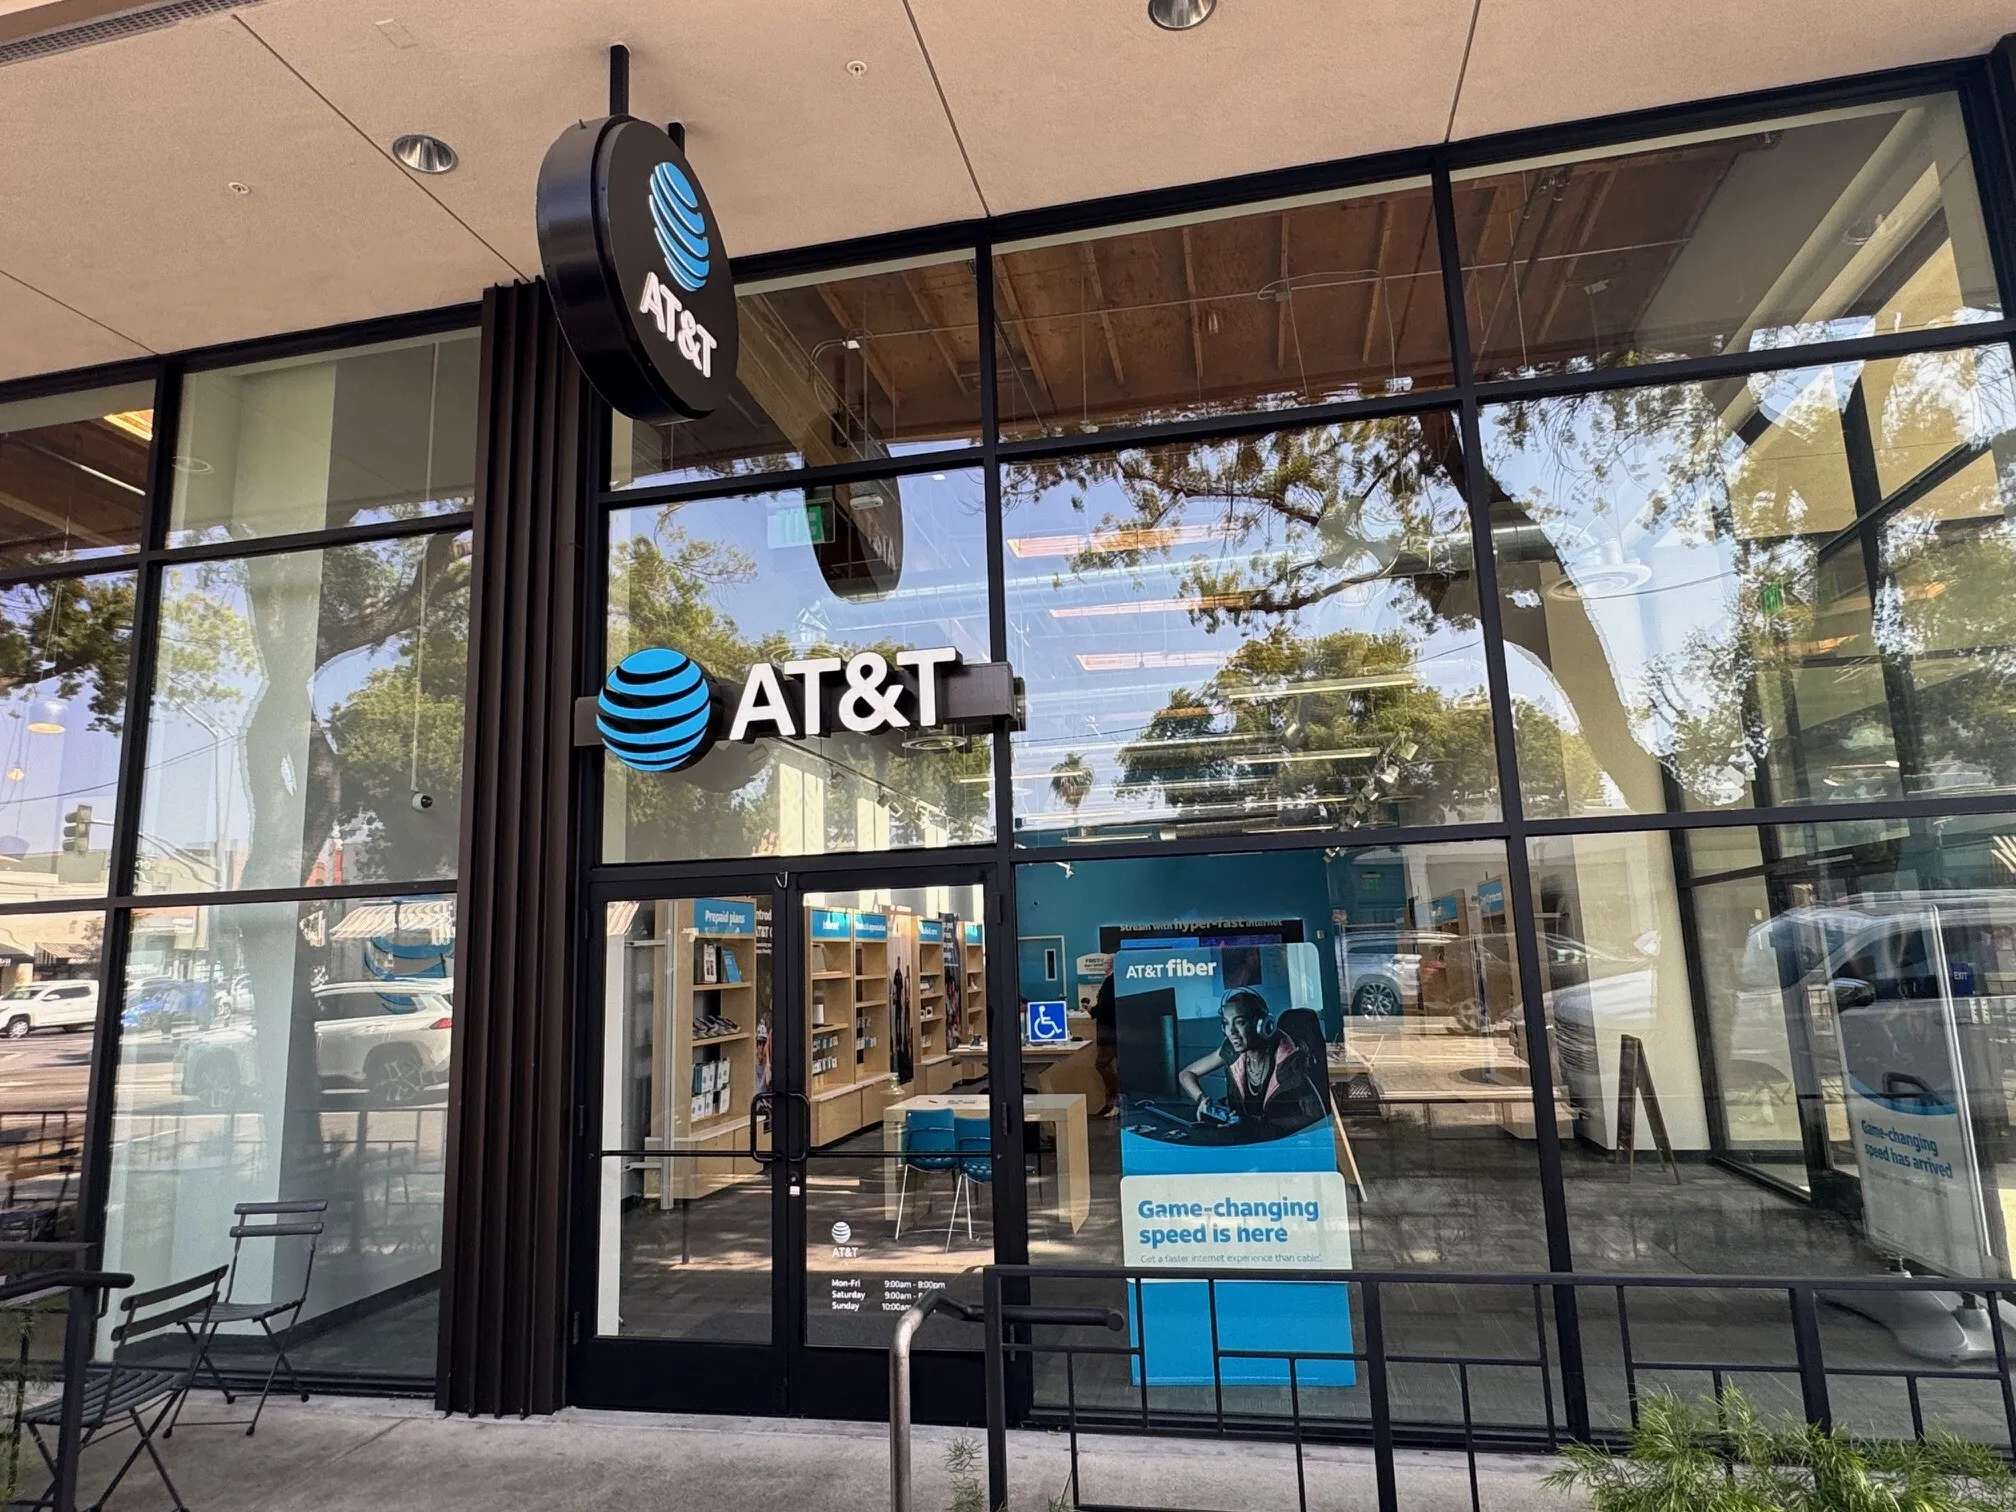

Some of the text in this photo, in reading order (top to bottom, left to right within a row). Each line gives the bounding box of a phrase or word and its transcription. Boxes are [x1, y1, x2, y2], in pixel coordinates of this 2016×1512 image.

[640, 272, 716, 378] AT&T
[729, 647, 956, 740] AT&T
[704, 910, 746, 926] Prepaid plans
[1120, 924, 1151, 932] Stream
[1174, 918, 1244, 933] hyper-fast
[1126, 958, 1217, 979] AT&T fiber
[1953, 971, 1968, 980] EXIT
[1861, 1120, 1939, 1157] Game-changing
[1864, 1143, 1954, 1179] speed has arrived
[1138, 1196, 1320, 1222] Game-changing
[1139, 1223, 1289, 1249] speed is here
[831, 1247, 859, 1258] AT&T
[1140, 1255, 1156, 1263] Get
[1165, 1253, 1189, 1263] faster
[1191, 1253, 1225, 1263] internet
[1226, 1254, 1274, 1264] experience
[1275, 1253, 1295, 1263] than
[831, 1279, 861, 1288] Mon-Fri
[884, 1281, 911, 1289] 9:00am
[917, 1281, 945, 1290] 8:00pm
[831, 1290, 866, 1301] Saturday
[884, 1292, 911, 1300] 9:00am
[831, 1301, 860, 1312] Sunday
